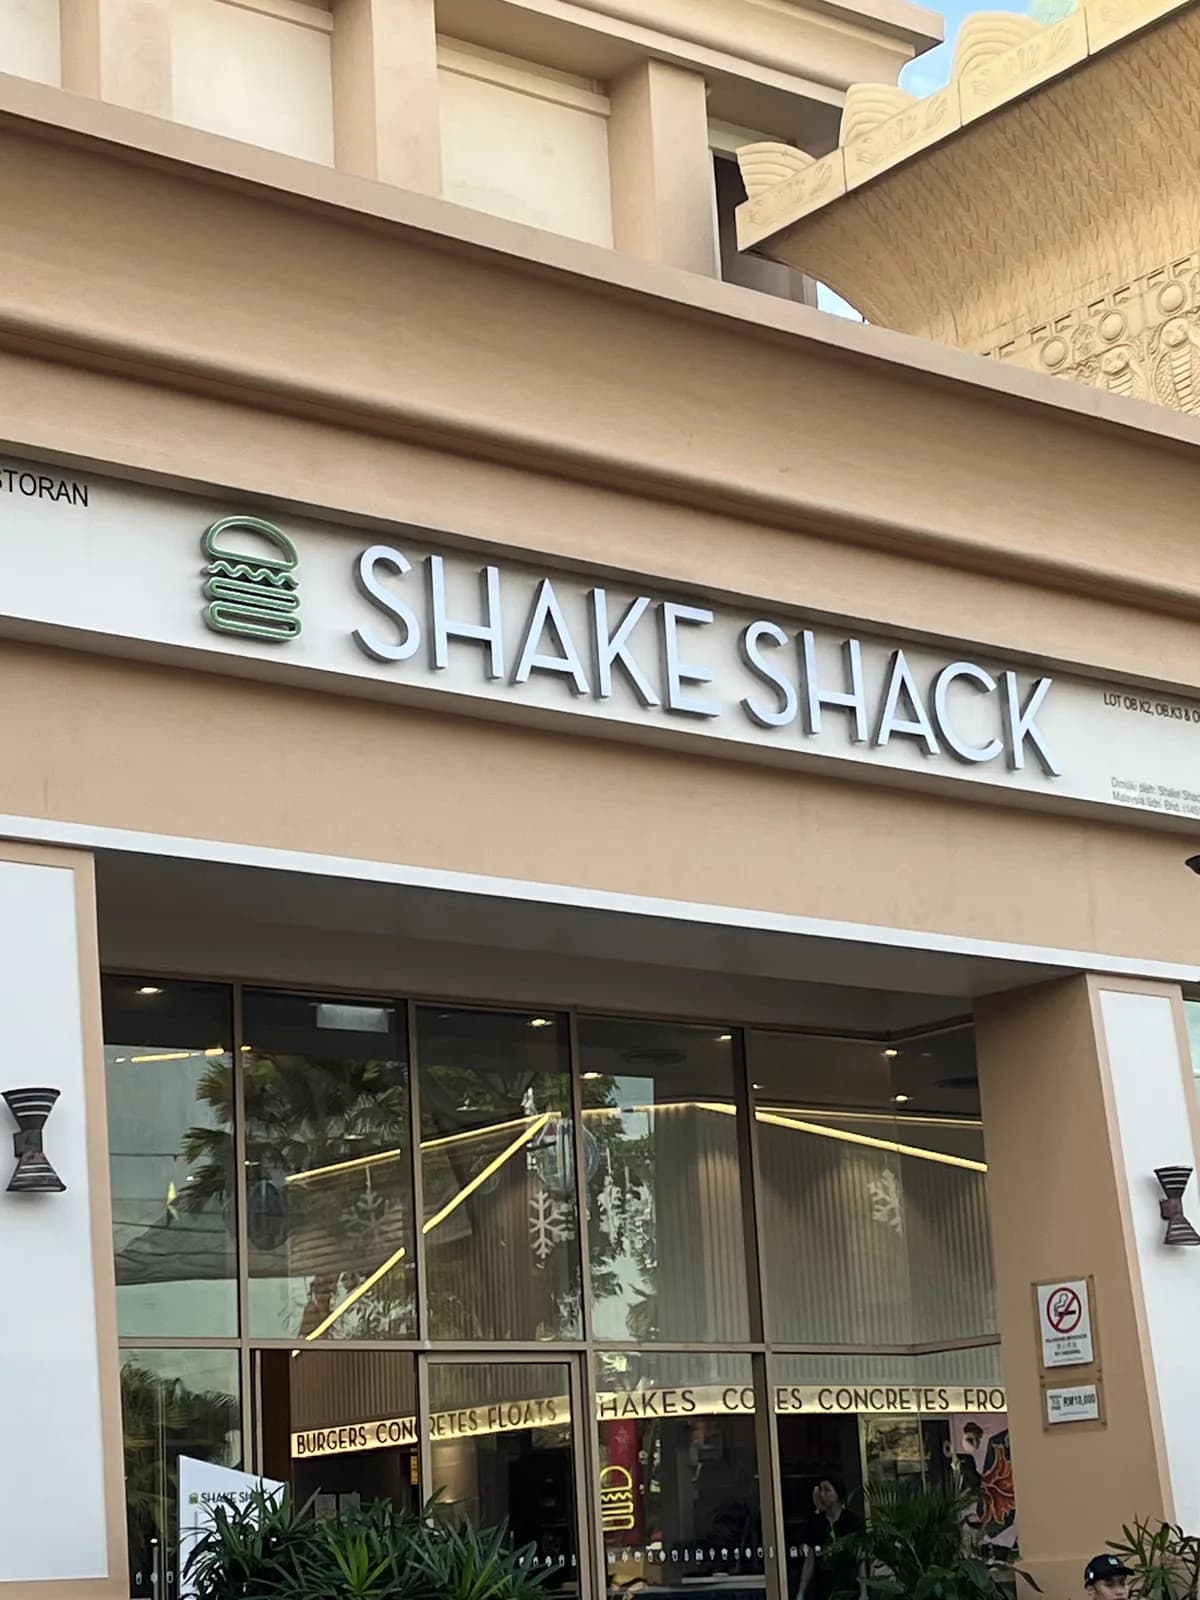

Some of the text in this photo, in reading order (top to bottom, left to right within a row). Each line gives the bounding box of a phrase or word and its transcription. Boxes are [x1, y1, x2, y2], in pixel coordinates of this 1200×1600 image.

[0, 468, 88, 507] TORAN
[351, 544, 1062, 778] SHAKE SHACK
[1104, 692, 1121, 708] LOT
[600, 1389, 696, 1417] HAKES
[818, 1388, 949, 1411] CONCRETES
[297, 1400, 557, 1454] BURGERS CONRETES FLOATS
